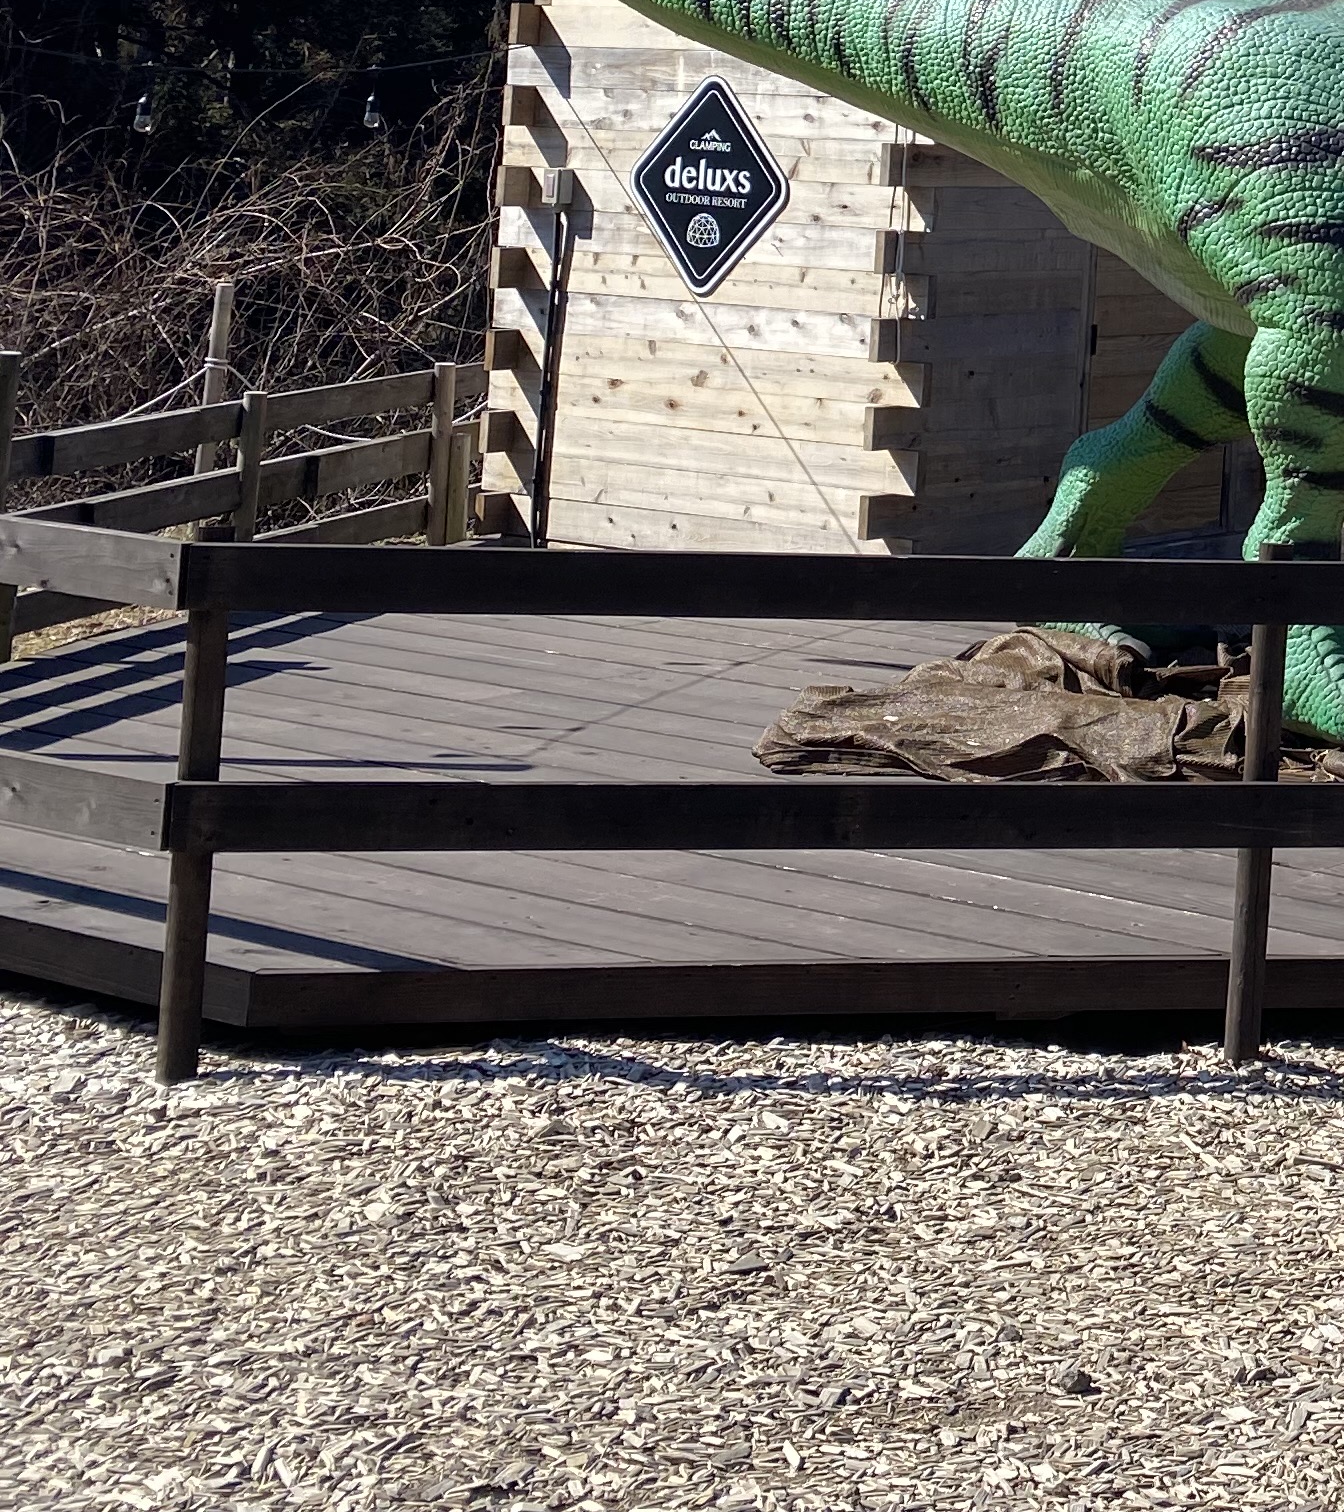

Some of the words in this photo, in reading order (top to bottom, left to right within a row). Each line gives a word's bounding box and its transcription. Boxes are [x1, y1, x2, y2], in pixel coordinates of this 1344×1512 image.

[664, 156, 750, 194] deluxs
[665, 192, 710, 205] OUTDOOR
[711, 196, 747, 208] RESORT
